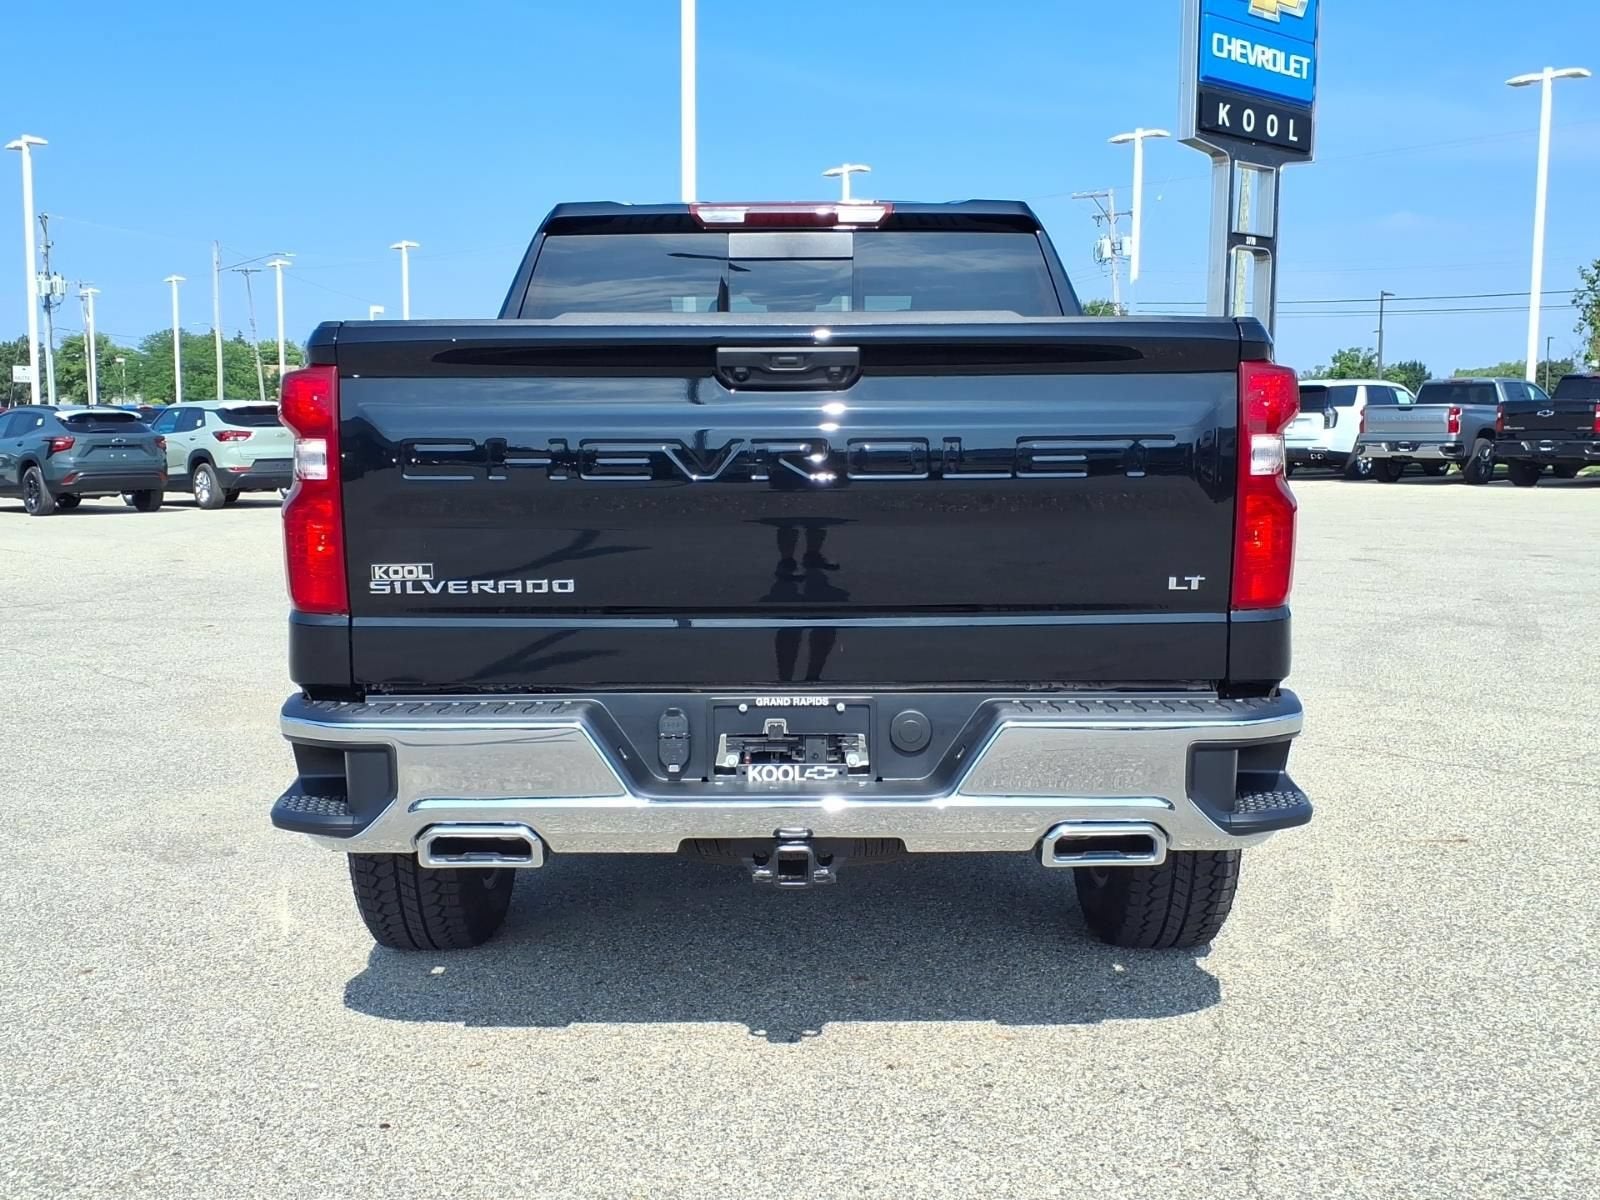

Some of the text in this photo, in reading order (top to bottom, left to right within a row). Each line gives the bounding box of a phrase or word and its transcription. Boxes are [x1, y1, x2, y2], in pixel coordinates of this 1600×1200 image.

[1212, 32, 1311, 80] CHEVROLET
[1218, 102, 1298, 142] KOOL
[401, 434, 1177, 482] CHEVROLET
[373, 565, 431, 579] KOOL
[369, 579, 575, 594] SILVERADO
[1168, 575, 1206, 590] LT
[755, 697, 830, 707] GRAND RAPIDS
[748, 765, 807, 782] KOOL
